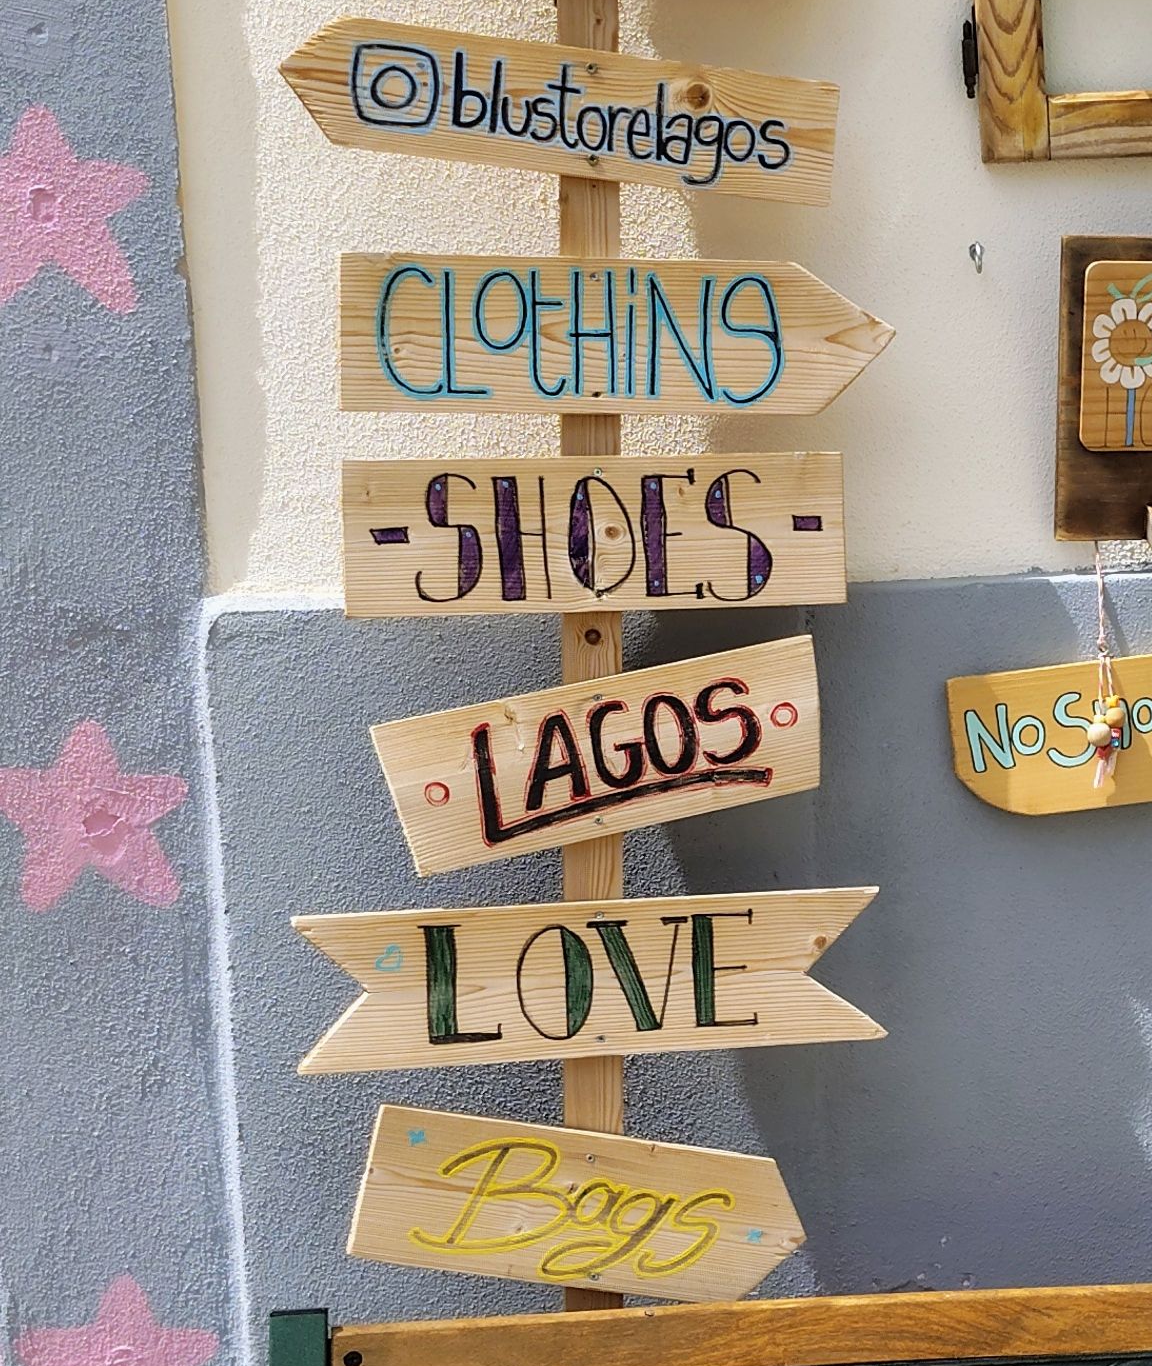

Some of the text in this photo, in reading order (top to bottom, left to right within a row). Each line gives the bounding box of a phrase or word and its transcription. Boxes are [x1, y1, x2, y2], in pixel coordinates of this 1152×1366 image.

[470, 676, 774, 848] LAGOS
[964, 703, 1046, 773] No
[417, 909, 759, 1045] LOVE
[409, 1136, 743, 1282] Bags
